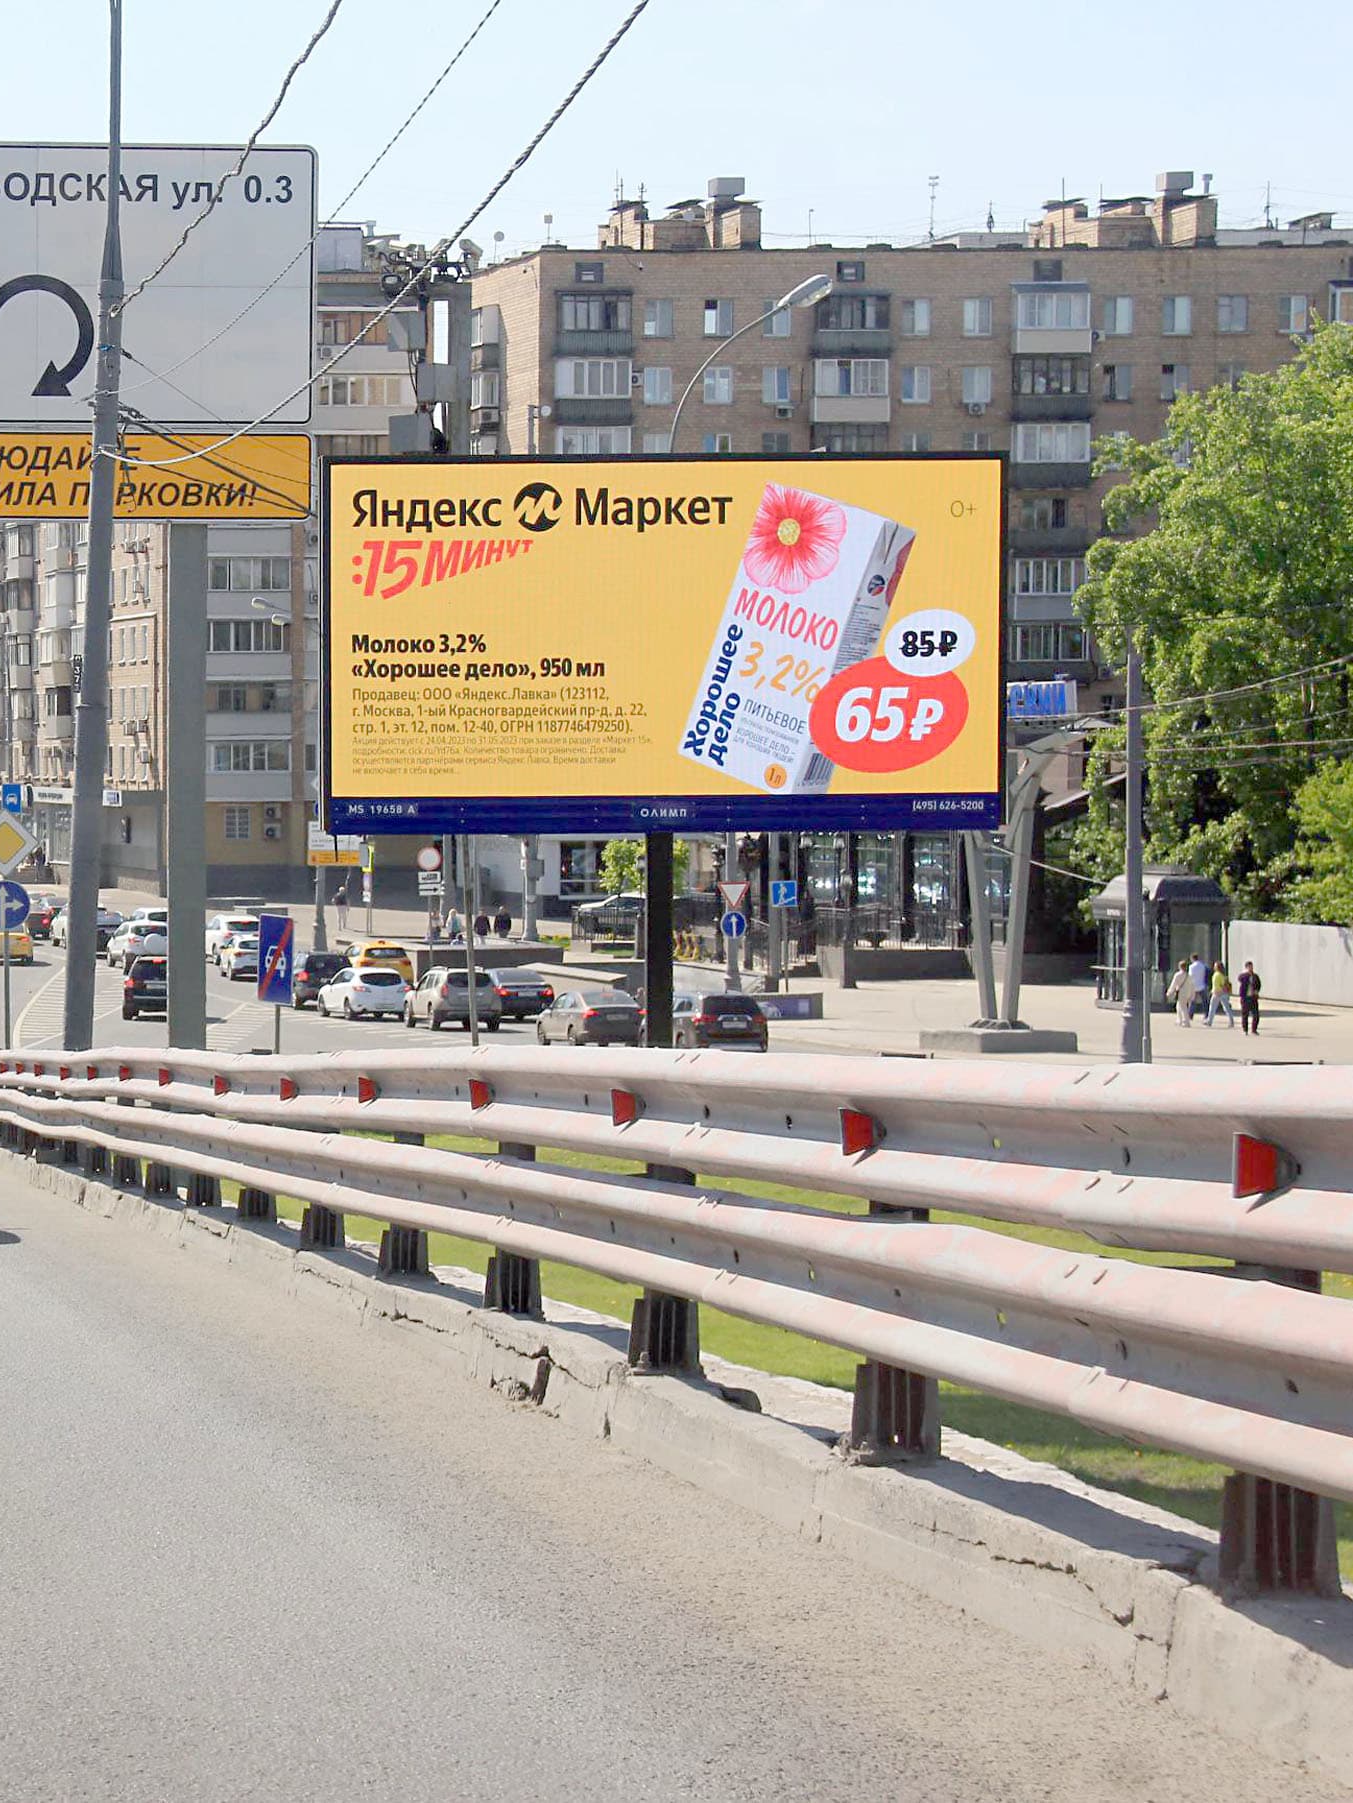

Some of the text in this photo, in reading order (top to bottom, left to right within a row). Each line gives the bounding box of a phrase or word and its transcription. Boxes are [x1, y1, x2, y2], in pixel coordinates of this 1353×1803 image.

[244, 175, 293, 203] 0.3
[68, 482, 257, 507] ПРКОВКИ!
[352, 489, 502, 533] Яндекс
[575, 487, 733, 532] Маркет
[950, 500, 977, 518] 0+
[734, 587, 838, 651] МОЛОКО
[352, 633, 486, 655] Молоко 3,2%
[352, 658, 605, 682] «Хорошее дело», 950 мл
[739, 641, 826, 704] 3,2%
[353, 686, 609, 702] Продавец: ООО «Яндекс.Лавка» (123112,
[683, 623, 744, 757] Хорошее
[352, 707, 360, 717] г.
[363, 704, 414, 718] Москва,
[417, 704, 446, 717] 1-ый
[449, 704, 577, 719] Красногвардейский
[744, 699, 807, 734] ПИТЬЕВОЕ
[352, 723, 377, 735] стр.
[411, 721, 428, 734] 12,
[431, 723, 459, 733] пом.
[463, 720, 497, 734] 12-40,
[500, 720, 534, 733] ОГРН
[707, 692, 741, 767] дело
[348, 804, 364, 815] MS
[639, 807, 687, 818] ОЛИМП
[939, 801, 984, 811] 626-5200
